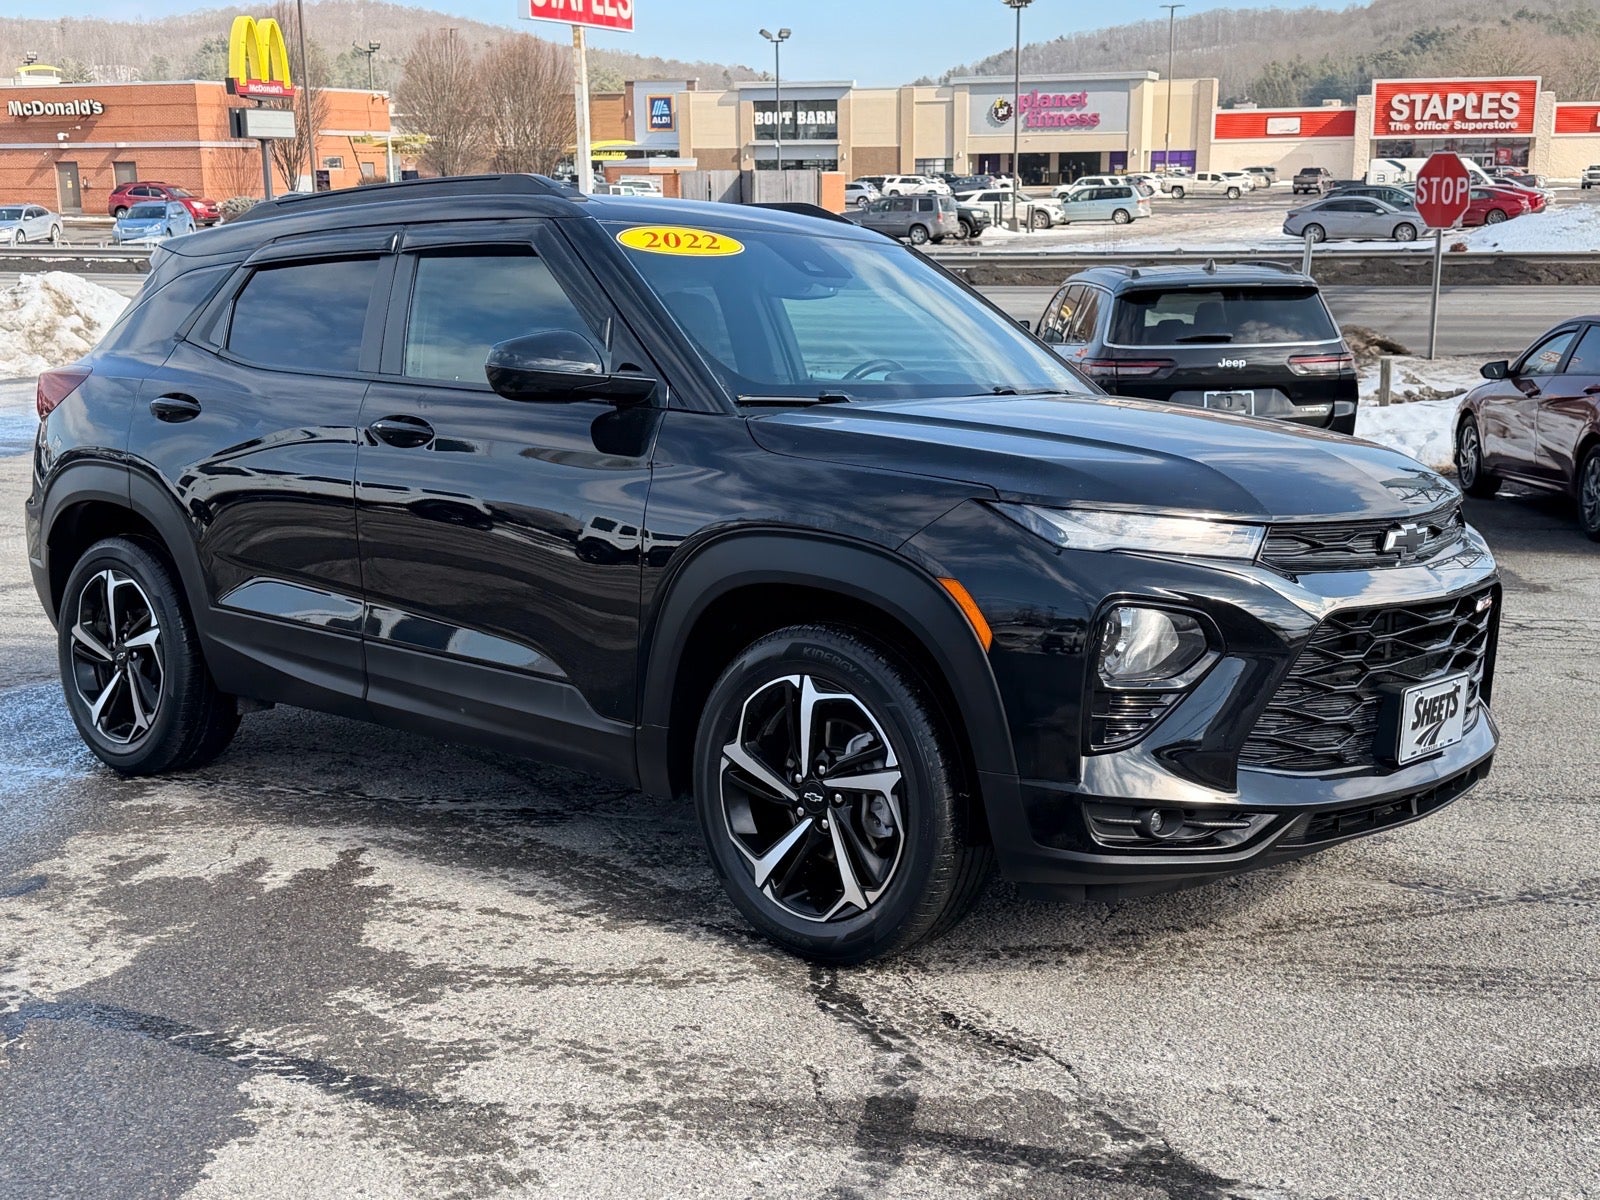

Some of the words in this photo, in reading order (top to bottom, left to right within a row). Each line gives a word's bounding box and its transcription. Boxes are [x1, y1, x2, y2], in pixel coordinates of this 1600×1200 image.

[249, 84, 283, 94] McDonald's
[7, 99, 104, 116] McDonald's
[1018, 89, 1088, 113] planet
[1389, 91, 1521, 121] STAPLES
[652, 116, 671, 124] ALDI
[754, 110, 793, 125] BOOT
[796, 110, 837, 125] BARN
[1026, 108, 1100, 128] fitness
[1388, 121, 1411, 131] The
[1414, 121, 1450, 131] Office
[1453, 120, 1519, 131] Superstore
[1416, 176, 1469, 205] STOP
[642, 231, 721, 250] 2022
[1217, 358, 1247, 369] Jeep
[1410, 684, 1461, 731] SHEETS
